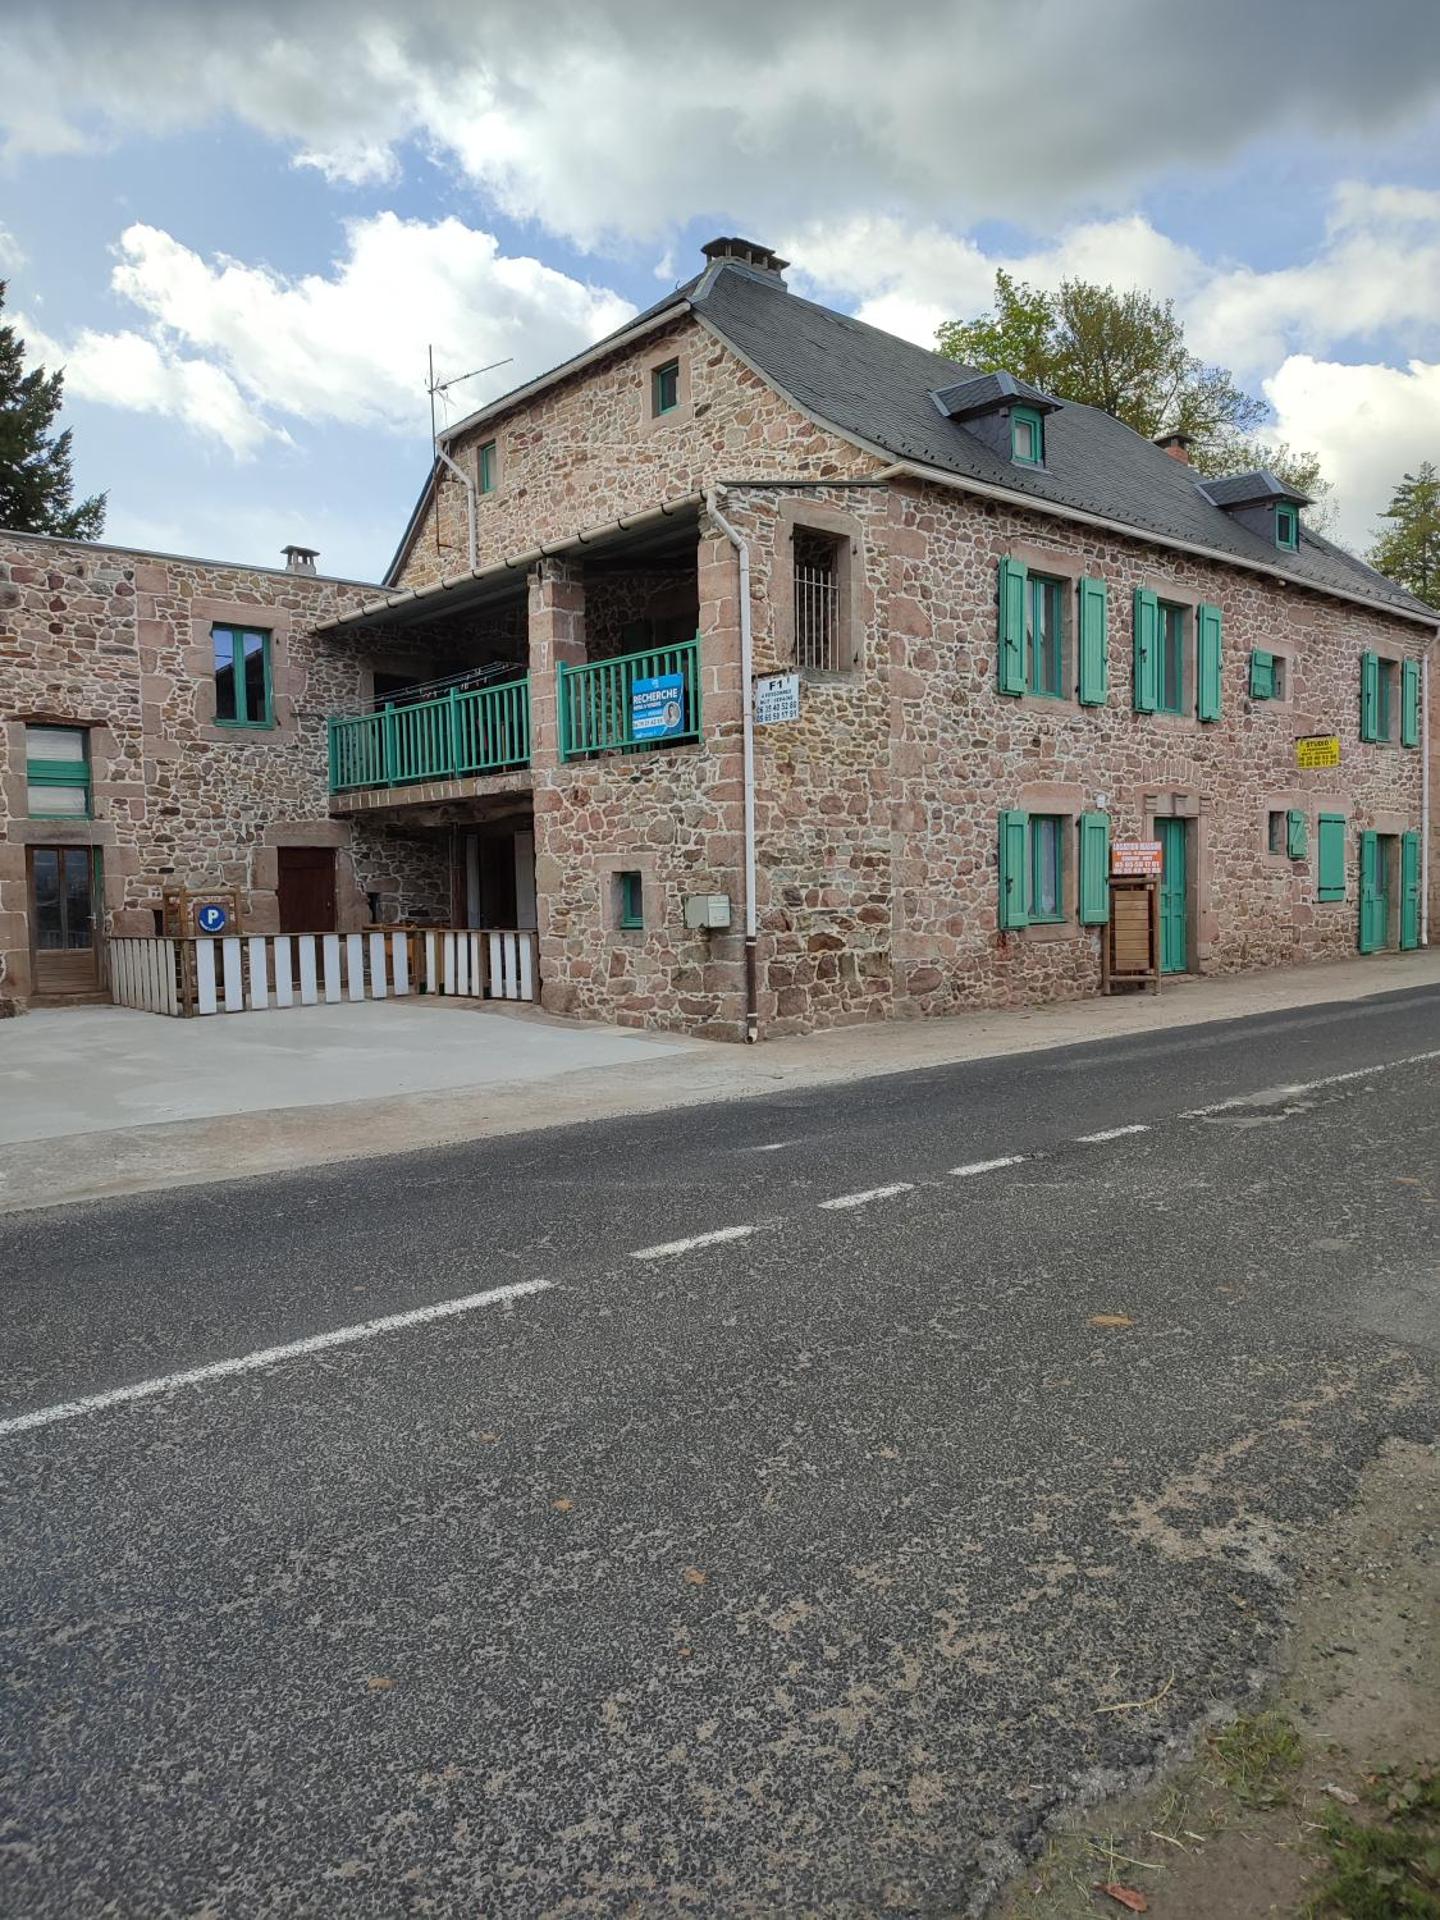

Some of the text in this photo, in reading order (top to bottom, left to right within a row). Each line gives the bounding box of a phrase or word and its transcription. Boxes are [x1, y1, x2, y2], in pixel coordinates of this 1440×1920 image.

[769, 680, 783, 690] F1
[633, 688, 678, 705] RECHERCHE
[781, 701, 788, 710] 52
[208, 910, 219, 924] P
